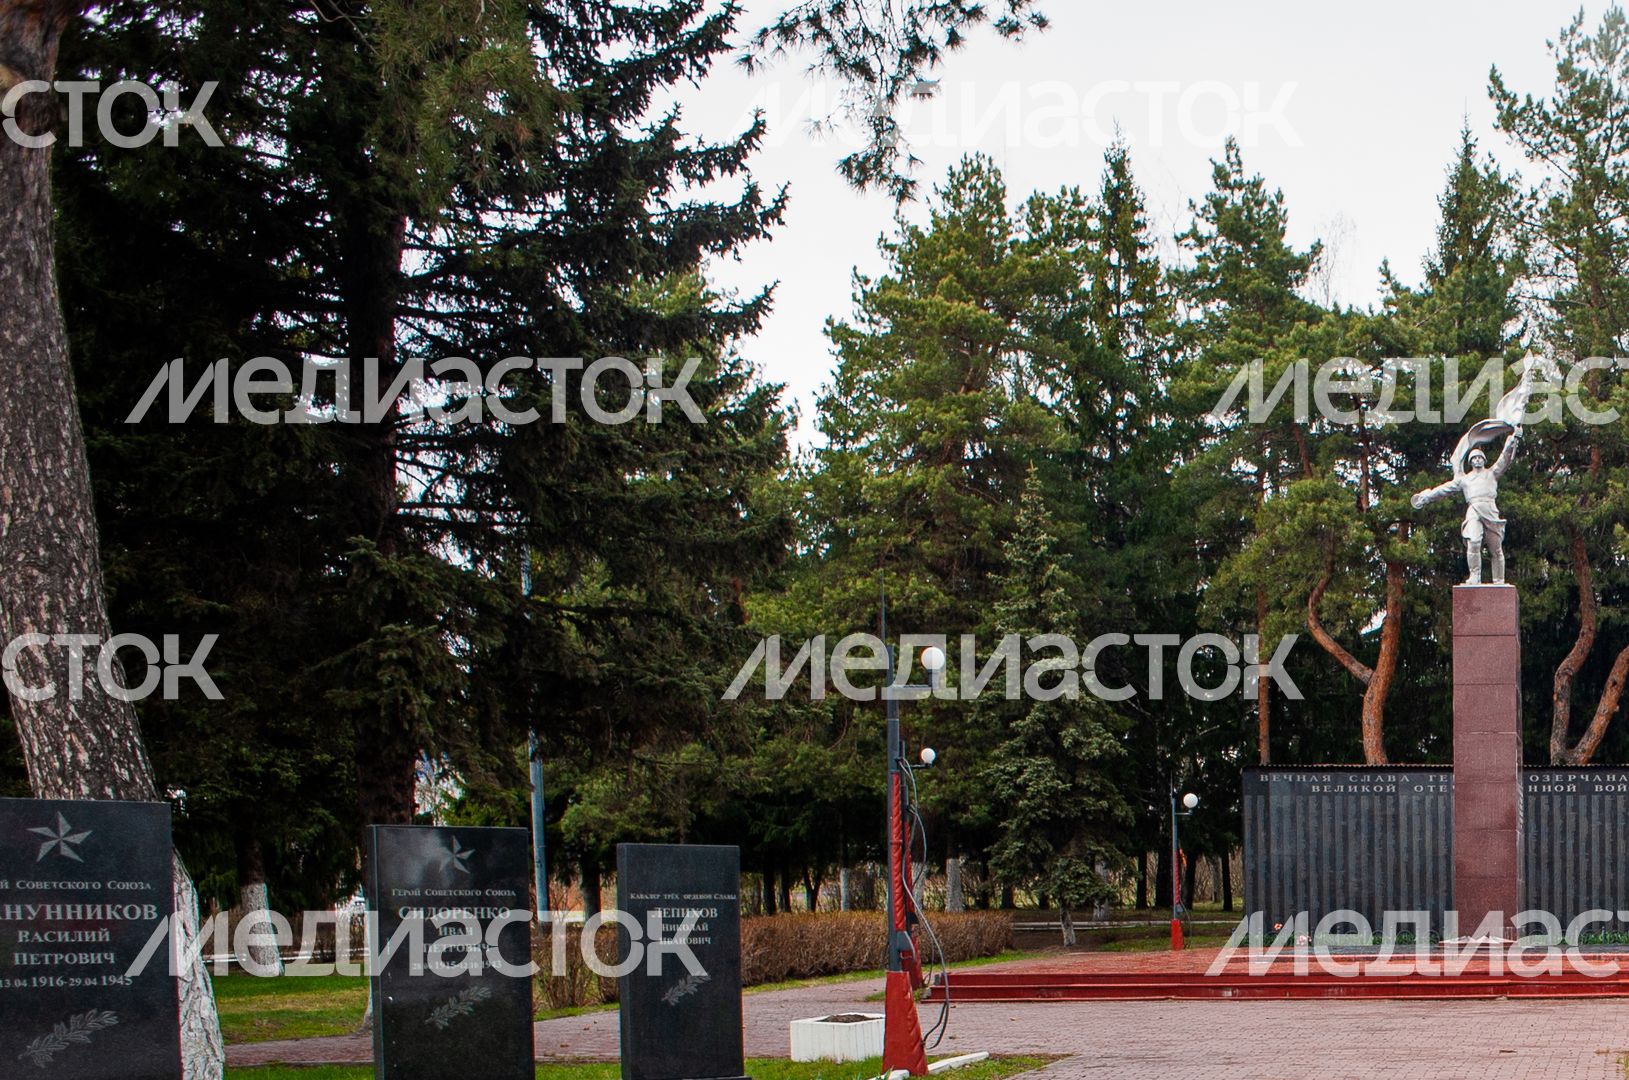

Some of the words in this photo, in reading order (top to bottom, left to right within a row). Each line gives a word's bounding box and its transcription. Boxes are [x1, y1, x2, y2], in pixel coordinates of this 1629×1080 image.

[1260, 774, 1332, 782] ВЕЧНАЯ
[1349, 774, 1410, 782] СЛАВА
[1312, 783, 1397, 793] ВЕЛИКОЙ
[0, 904, 158, 920] НУННИКОВ
[18, 928, 110, 943] ВАСИЛИЙ
[14, 952, 116, 965] ПЕТРОВИЧ
